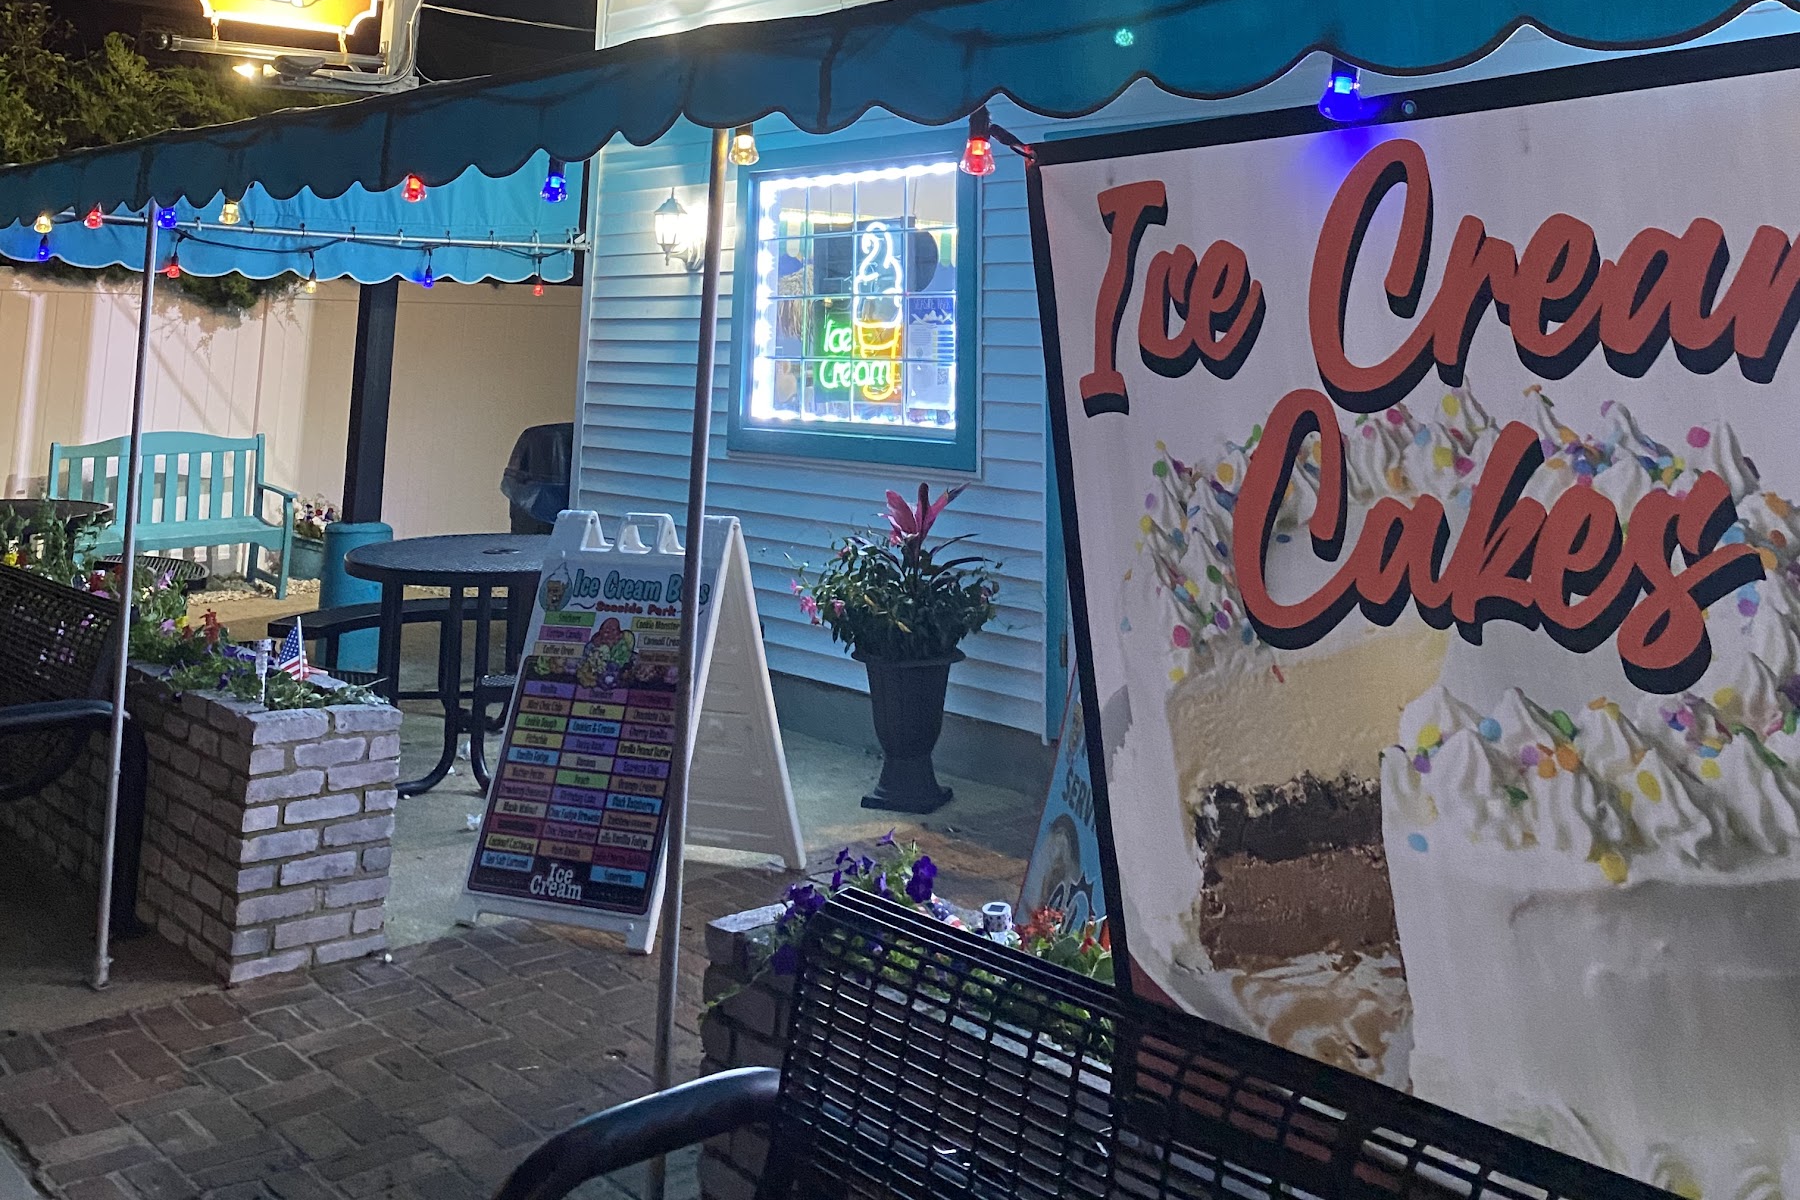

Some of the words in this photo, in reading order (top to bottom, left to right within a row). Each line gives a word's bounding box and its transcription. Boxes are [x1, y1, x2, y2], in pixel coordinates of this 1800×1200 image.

[1079, 179, 1267, 416] Ice
[822, 319, 856, 354] Ice
[818, 358, 894, 390] Cream
[1232, 388, 1767, 696] Cakes
[573, 568, 601, 598] Ice
[604, 570, 662, 601] Cream
[666, 574, 710, 605] Bs
[595, 601, 643, 614] Seaside
[647, 604, 677, 617] Park
[529, 875, 583, 901] Cream
[549, 862, 575, 884] Ice
